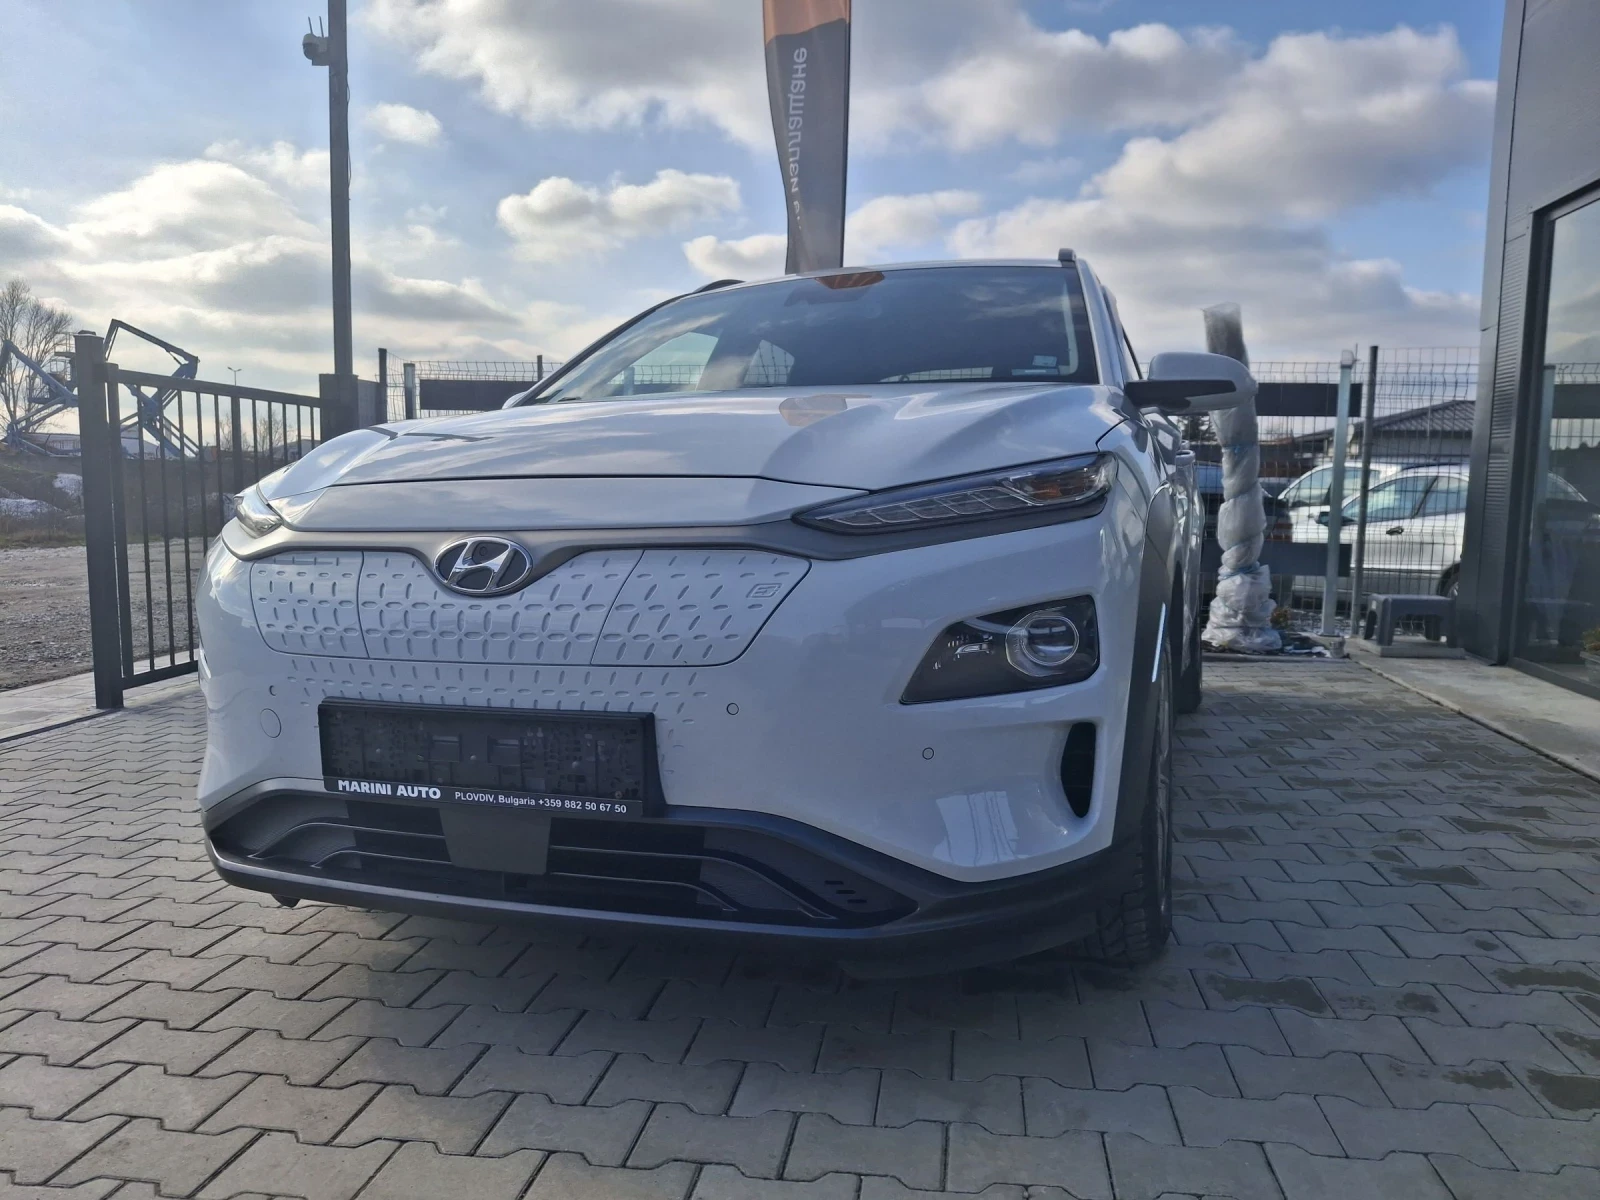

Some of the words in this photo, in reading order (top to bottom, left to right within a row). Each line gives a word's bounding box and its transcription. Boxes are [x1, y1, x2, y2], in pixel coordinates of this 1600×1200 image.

[337, 779, 392, 796] MARINI
[396, 784, 442, 800] AUTO
[454, 791, 497, 804] PLOVDIV,
[498, 794, 536, 806] Bulgaria
[538, 798, 562, 808] +359
[564, 799, 582, 810] 882
[585, 801, 597, 811] 50
[600, 803, 612, 812] 67
[614, 804, 627, 814] 50
